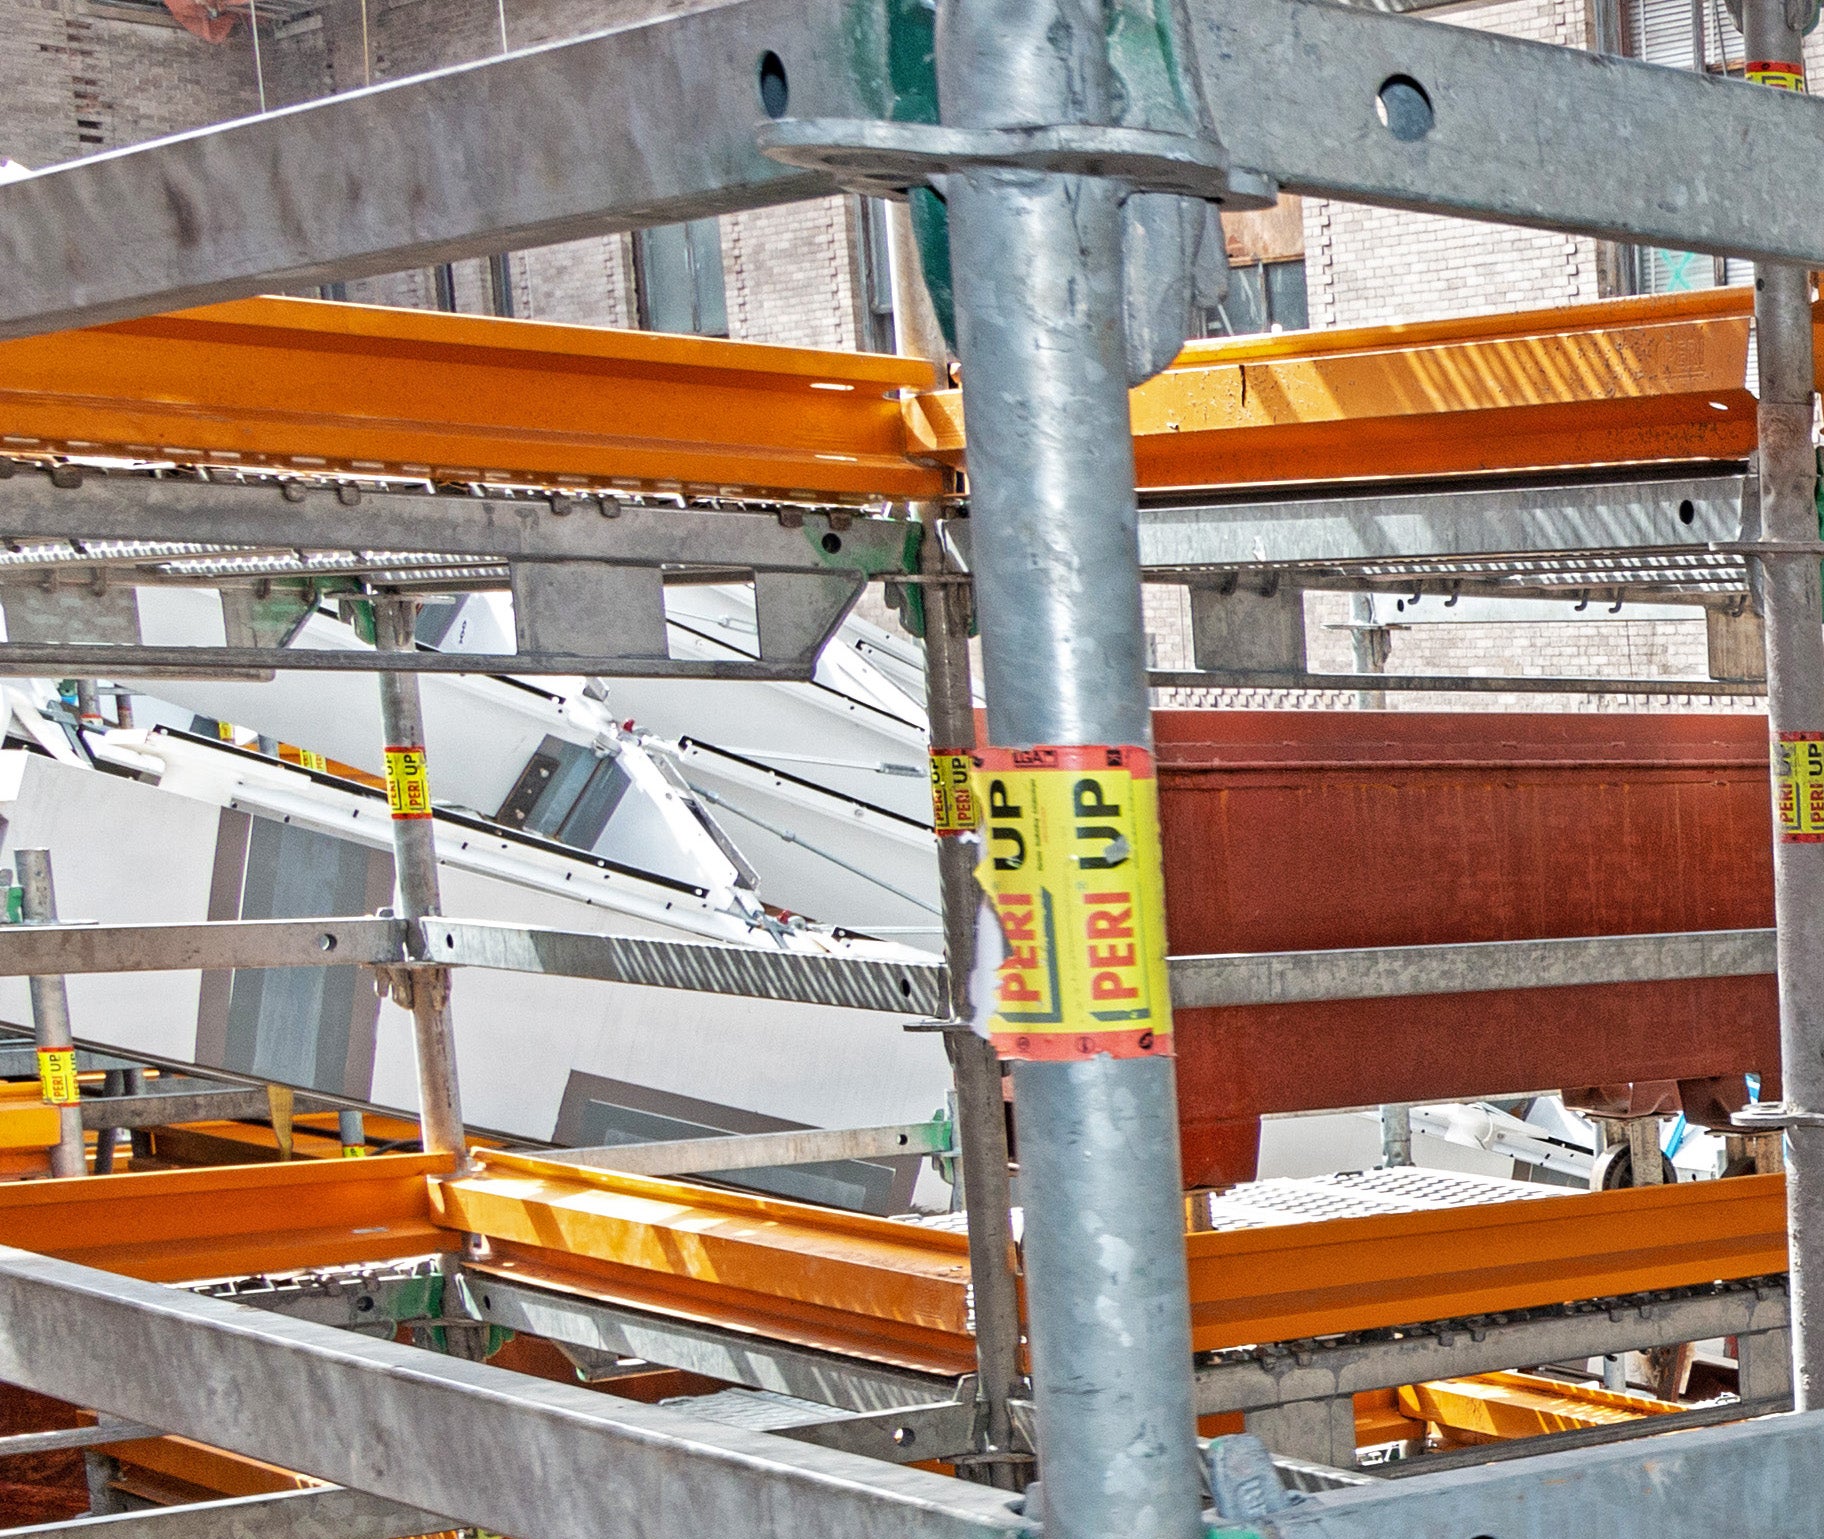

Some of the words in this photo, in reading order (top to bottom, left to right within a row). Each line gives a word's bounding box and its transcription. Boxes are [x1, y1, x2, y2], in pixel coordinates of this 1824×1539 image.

[403, 754, 418, 776] UP
[952, 757, 968, 784] UP
[1808, 743, 1823, 776] UP
[407, 780, 422, 806] PERI
[955, 788, 972, 821] PERI
[1809, 783, 1824, 823] PERI
[990, 779, 1026, 871] UP
[1073, 778, 1130, 870] UP
[998, 893, 1041, 1002] PERI
[1083, 891, 1139, 1001] PERI
[49, 1054, 62, 1072] UP
[51, 1075, 65, 1097] PERI
